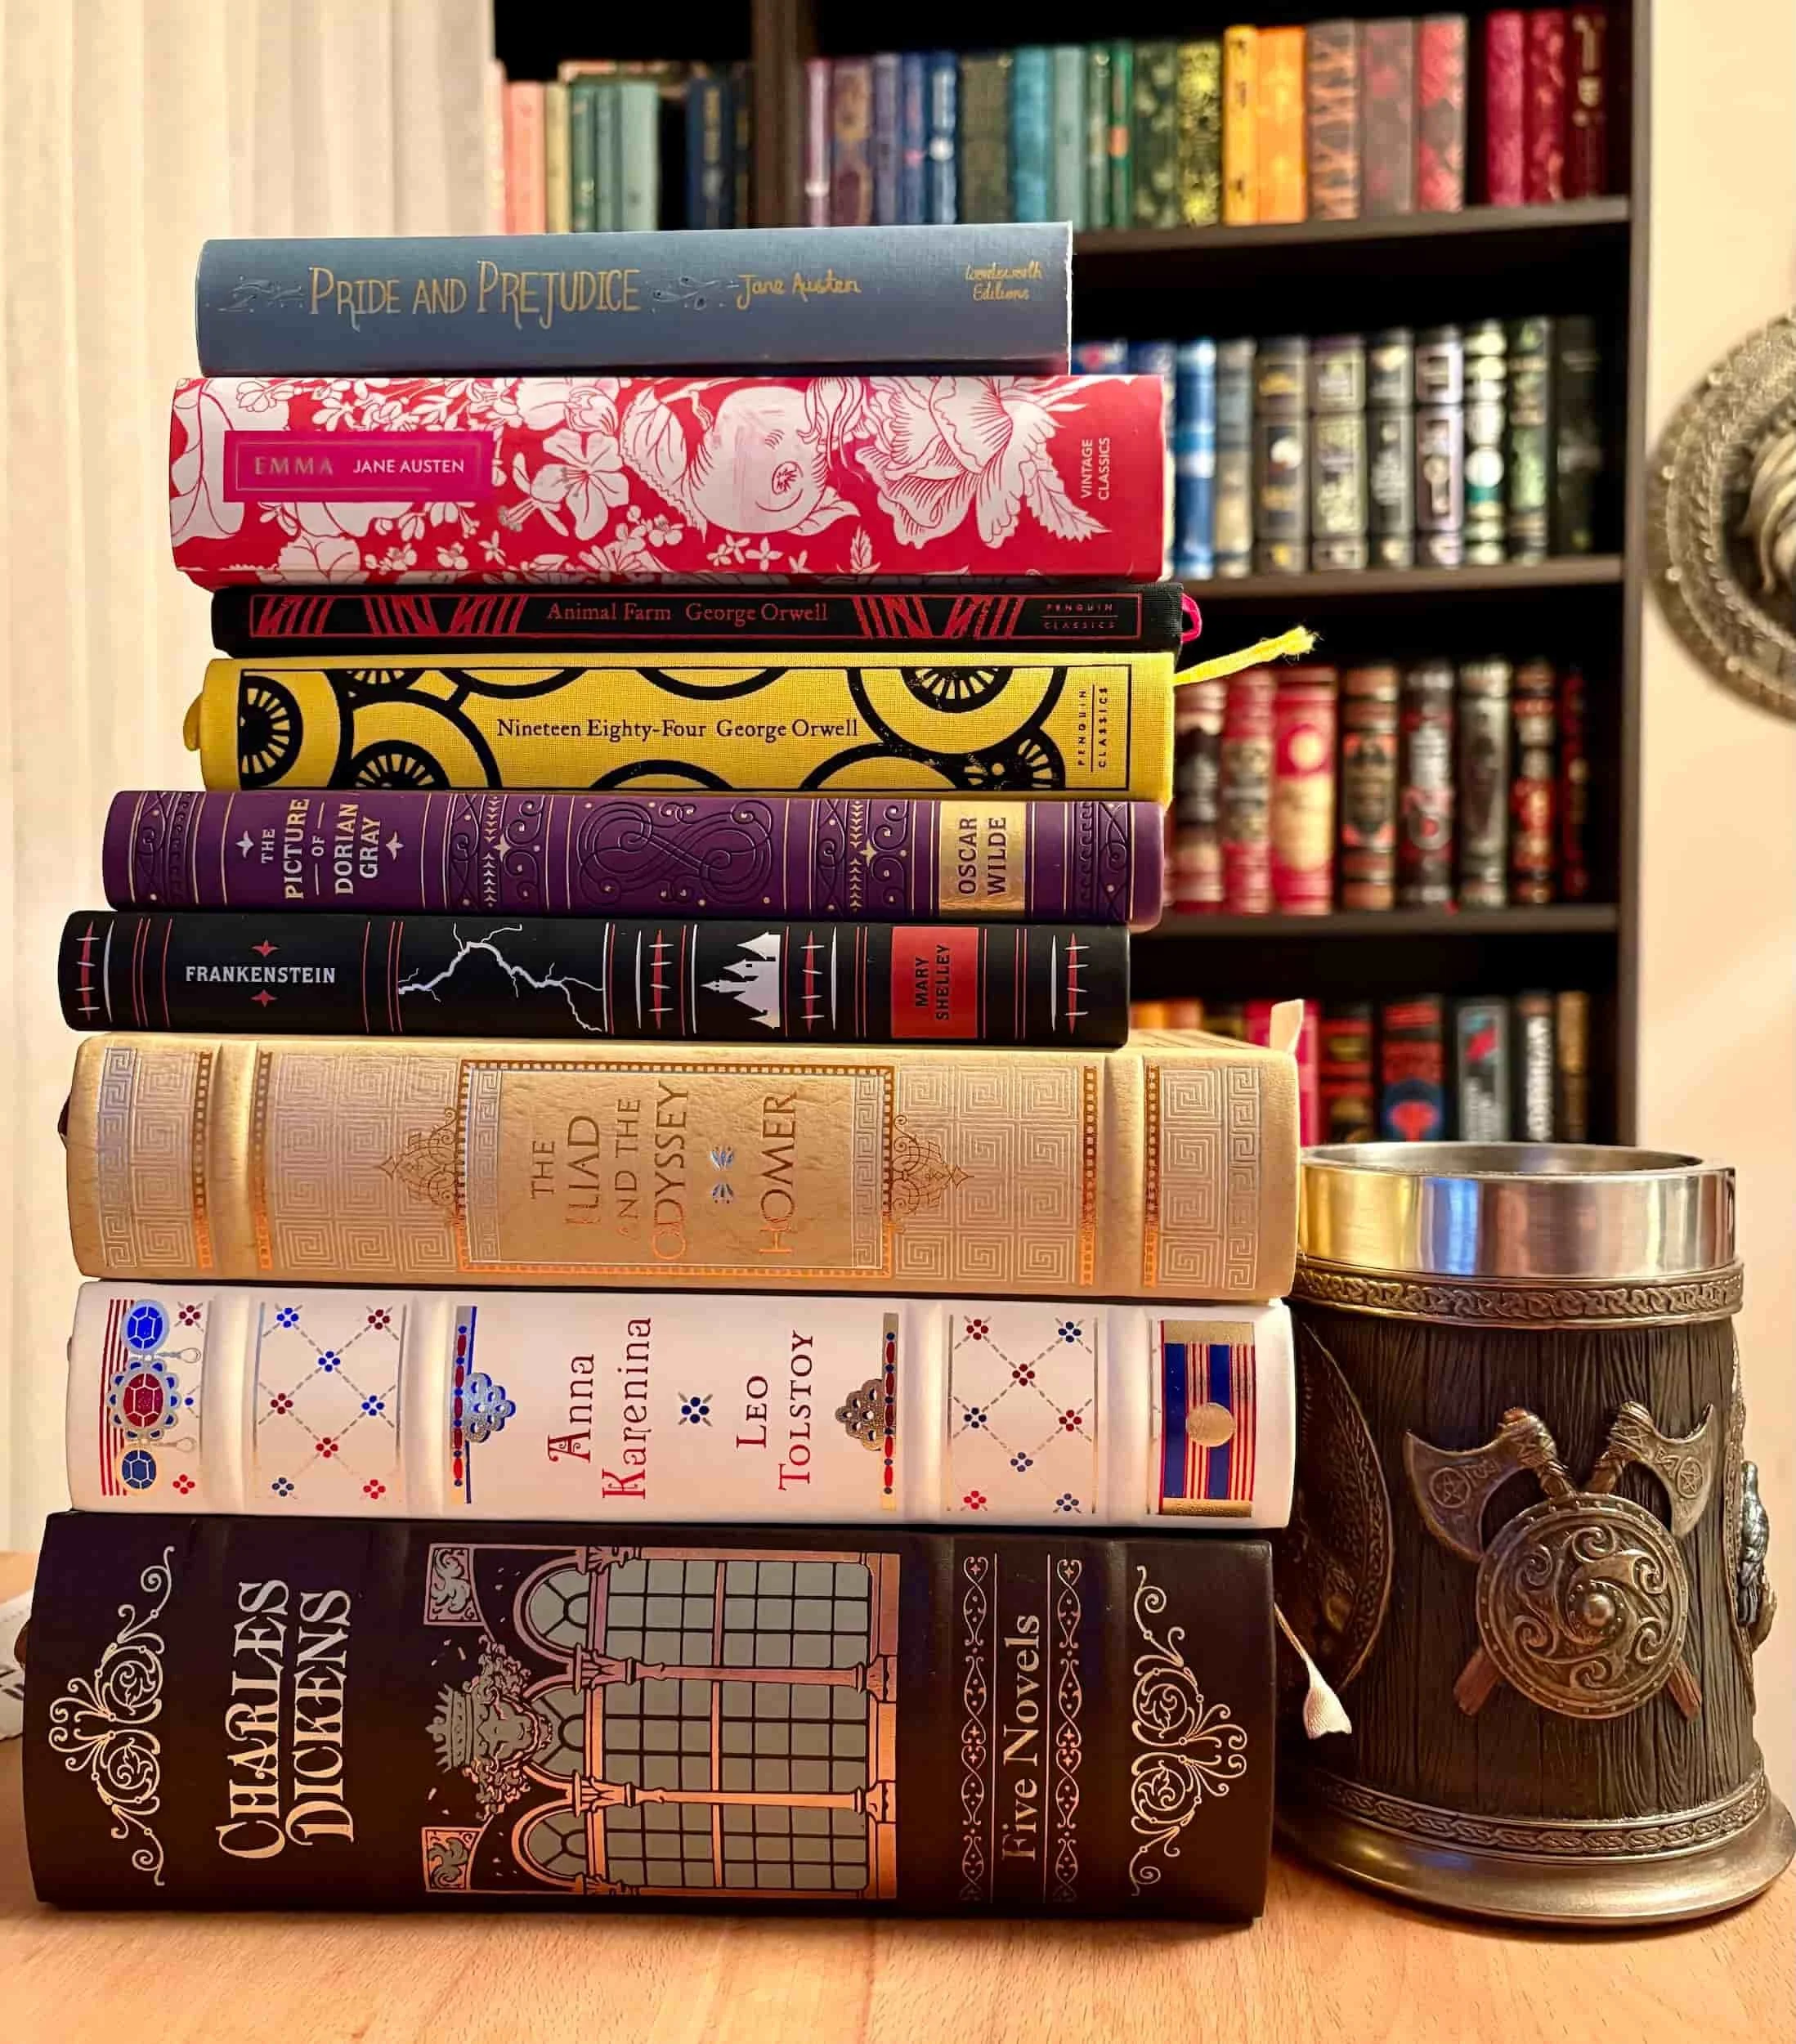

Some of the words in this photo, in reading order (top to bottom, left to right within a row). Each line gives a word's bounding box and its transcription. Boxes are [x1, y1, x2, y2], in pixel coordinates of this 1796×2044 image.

[309, 266, 401, 331] PRIDE
[412, 278, 467, 314] AND
[477, 260, 642, 330] PREJUDICE
[737, 274, 785, 309] Jane
[792, 269, 861, 302] Austen
[254, 455, 334, 476] EMMA
[353, 459, 396, 474] JANE
[399, 459, 464, 474] AUSTEN
[1080, 439, 1093, 499] VINTAGE
[1099, 437, 1110, 500] CLASSICS
[547, 603, 617, 621] Animal
[624, 603, 671, 621] Farm
[686, 603, 756, 628] George
[760, 603, 828, 621] Orwell
[1044, 621, 1115, 630] CLASSICS
[1046, 603, 1113, 612] PENGUIN
[497, 719, 581, 737] Nineteen
[587, 719, 706, 743] Eighty-Four
[716, 719, 786, 742] George
[791, 719, 858, 737] Orwell
[1077, 689, 1086, 766] PENGUIN
[1099, 688, 1108, 768] CLASSICS
[261, 828, 275, 864] THE
[283, 798, 310, 899] PICTURE
[311, 836, 325, 857] OF
[334, 804, 359, 894] DORIAN
[359, 817, 381, 879] GRAY
[958, 818, 978, 894] OSCAR
[988, 817, 1007, 895] WILDE
[186, 966, 336, 984] FRANKENSTEIN
[915, 957, 929, 1007] MARY
[936, 944, 951, 1020] SHELLEY
[615, 1097, 641, 1159] THE
[530, 1141, 556, 1199] THE
[566, 1114, 601, 1225] ILIAD
[614, 1169, 640, 1241] AND
[651, 1080, 688, 1261] ODYSSEY
[759, 1091, 798, 1254] HOMER
[547, 1354, 595, 1463] Anna
[602, 1318, 652, 1499] Karenina
[736, 1375, 768, 1450] LEO
[777, 1329, 813, 1490] TOLSTOY
[216, 1580, 289, 1859] CHARLES
[285, 1589, 354, 1846] DICKENS
[1003, 1614, 1040, 1767] Novels
[1001, 1777, 1038, 1862] Five
